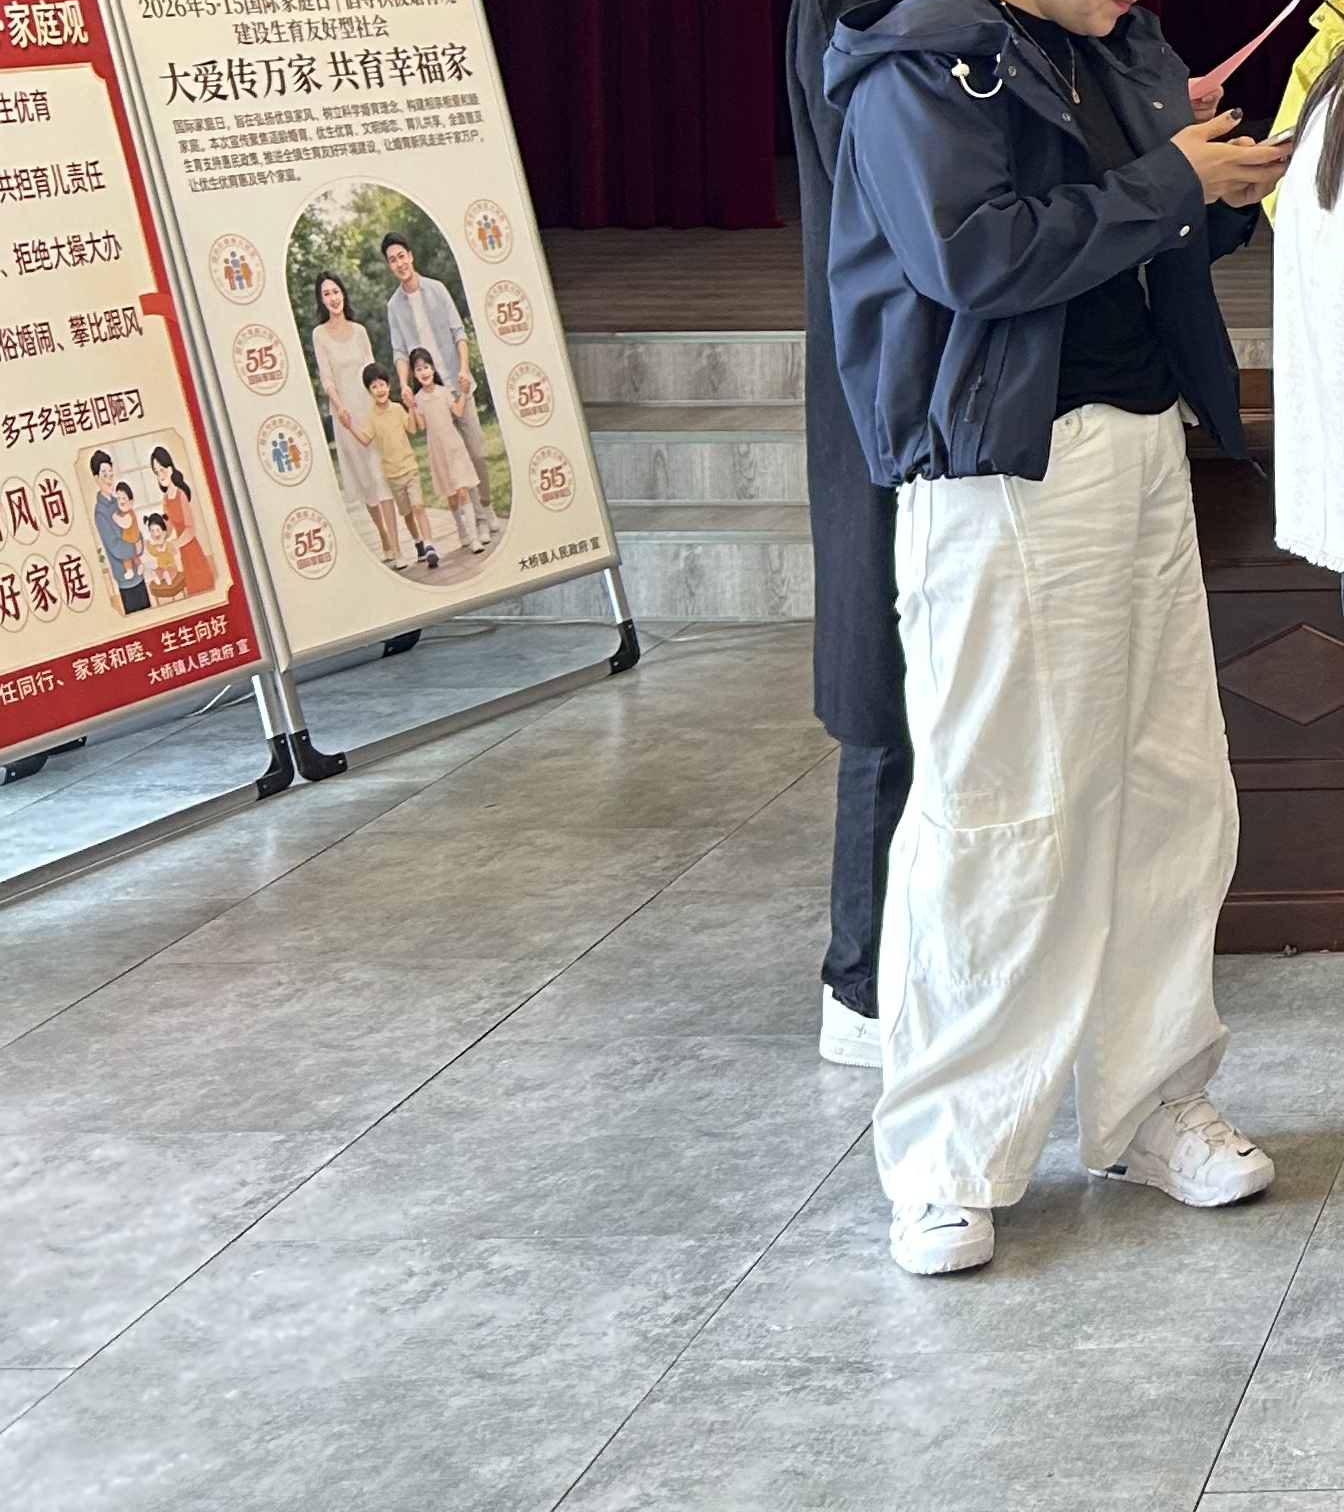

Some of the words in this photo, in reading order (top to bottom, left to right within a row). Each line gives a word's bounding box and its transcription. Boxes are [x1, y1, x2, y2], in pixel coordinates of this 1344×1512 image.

[233, 14, 389, 45] 建设生育友好型社会
[159, 54, 322, 105] 大爱传万家
[328, 43, 473, 93] 共育幸福家
[0, 306, 143, 362] 俗婚闹、攀比跟风
[1, 388, 145, 449] 多子多福老旧陋习
[518, 539, 589, 571] 大桥镇人民政府
[590, 536, 602, 550] 宣
[148, 643, 235, 685] 大桥镇人民政府
[236, 638, 251, 656] 宣
